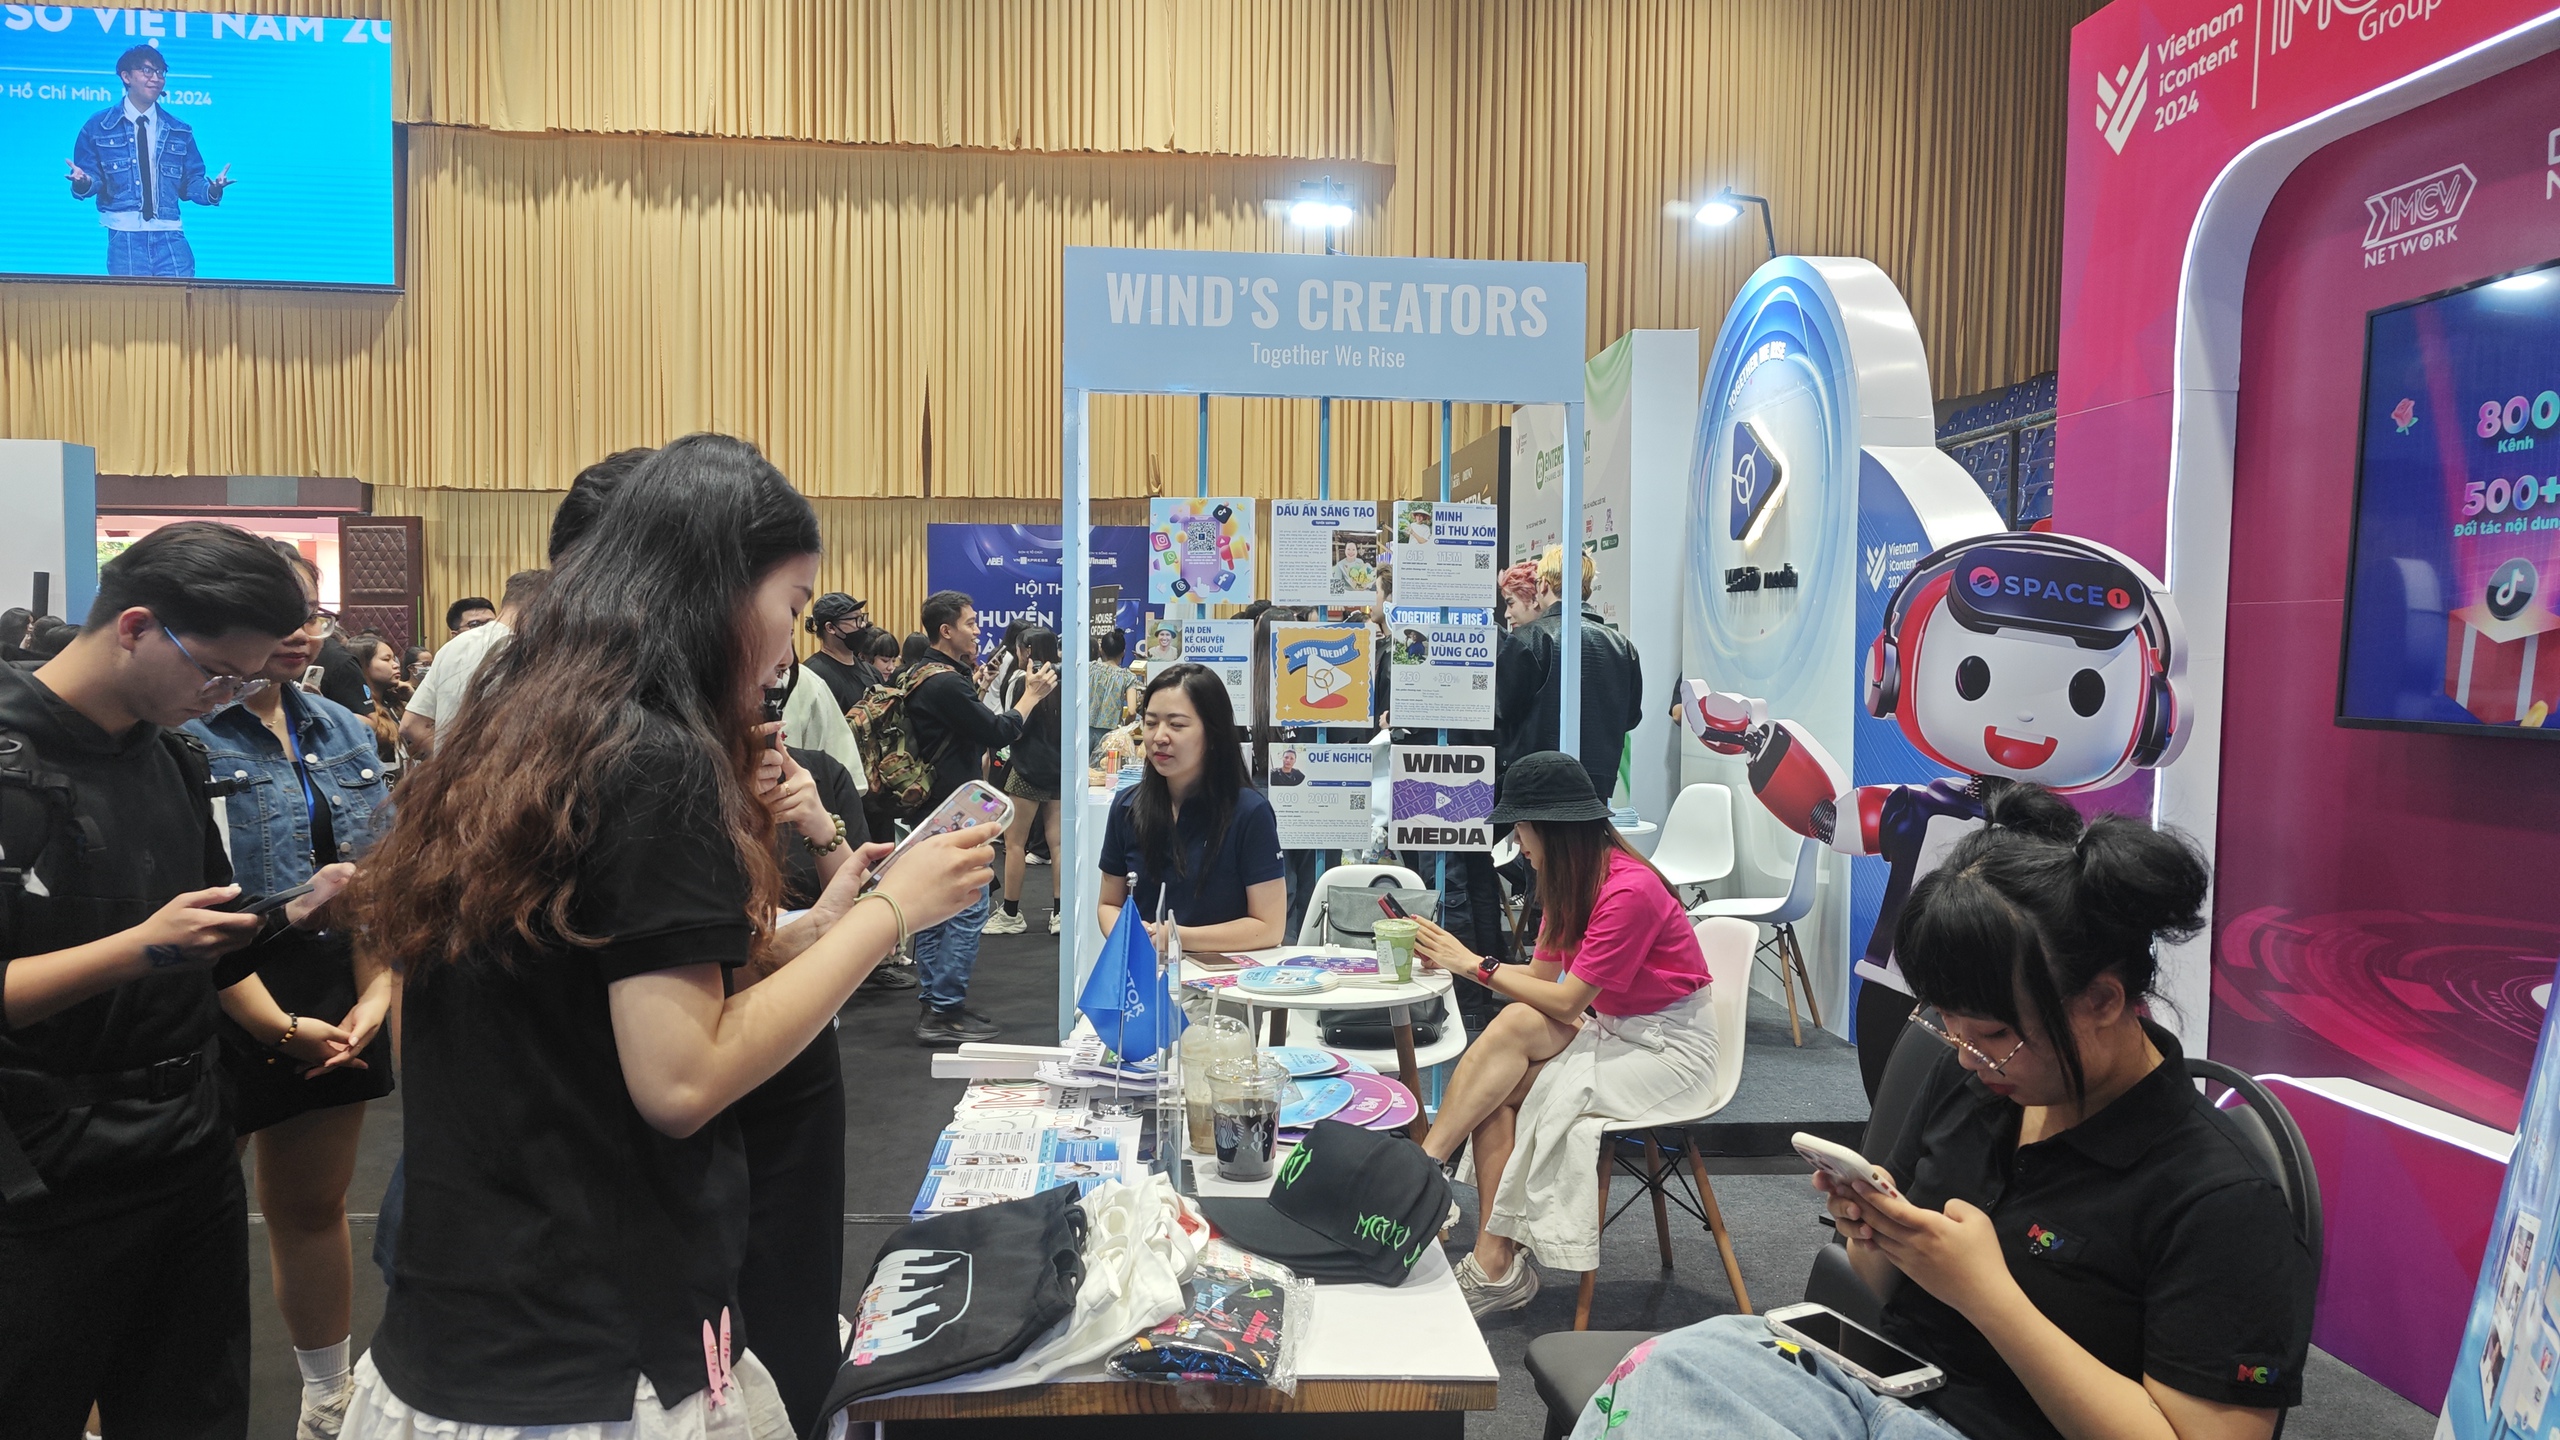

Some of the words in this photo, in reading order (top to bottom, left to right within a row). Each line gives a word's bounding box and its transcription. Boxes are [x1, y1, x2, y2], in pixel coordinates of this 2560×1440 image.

[2157, 3, 2243, 65] Vietnam
[2159, 37, 2238, 97] iContent
[38, 85, 66, 101] Chí
[71, 87, 111, 102] Minh
[2154, 90, 2199, 133] 2024
[2389, 173, 2461, 232] MCV
[2364, 224, 2458, 268] NETWORK
[1297, 278, 1548, 338] CREATORS
[1251, 342, 1329, 368] Together
[1335, 344, 1363, 367] We
[1368, 346, 1406, 369] Rise
[2476, 390, 2560, 438] 800
[2497, 435, 2535, 454] Kênh
[1435, 511, 1463, 522] MINH
[1448, 525, 1469, 536] THƯ
[1471, 525, 1496, 537] XÓM
[2453, 519, 2477, 537] Đối
[2480, 519, 2502, 535] tác
[2505, 517, 2528, 536] nội
[1406, 550, 1424, 561] 615
[1437, 551, 1462, 563] 115M
[1888, 541, 1919, 557] Vietnam
[1889, 558, 1917, 572] iContent
[1015, 579, 1042, 598] HỘI
[2004, 575, 2105, 607] SPACE
[977, 601, 1054, 628] HUYỂN
[1462, 612, 1483, 626] RISE
[1431, 632, 1466, 643] OLALA
[1465, 647, 1488, 658] CAO
[1400, 671, 1420, 683] 250
[1333, 752, 1372, 764] NGHỊCH
[1403, 753, 1485, 774] WIND
[1277, 792, 1298, 804] 600
[1308, 792, 1338, 804] 200M
[1397, 827, 1487, 845] MEDIA
[2027, 1223, 2065, 1251] MCV
